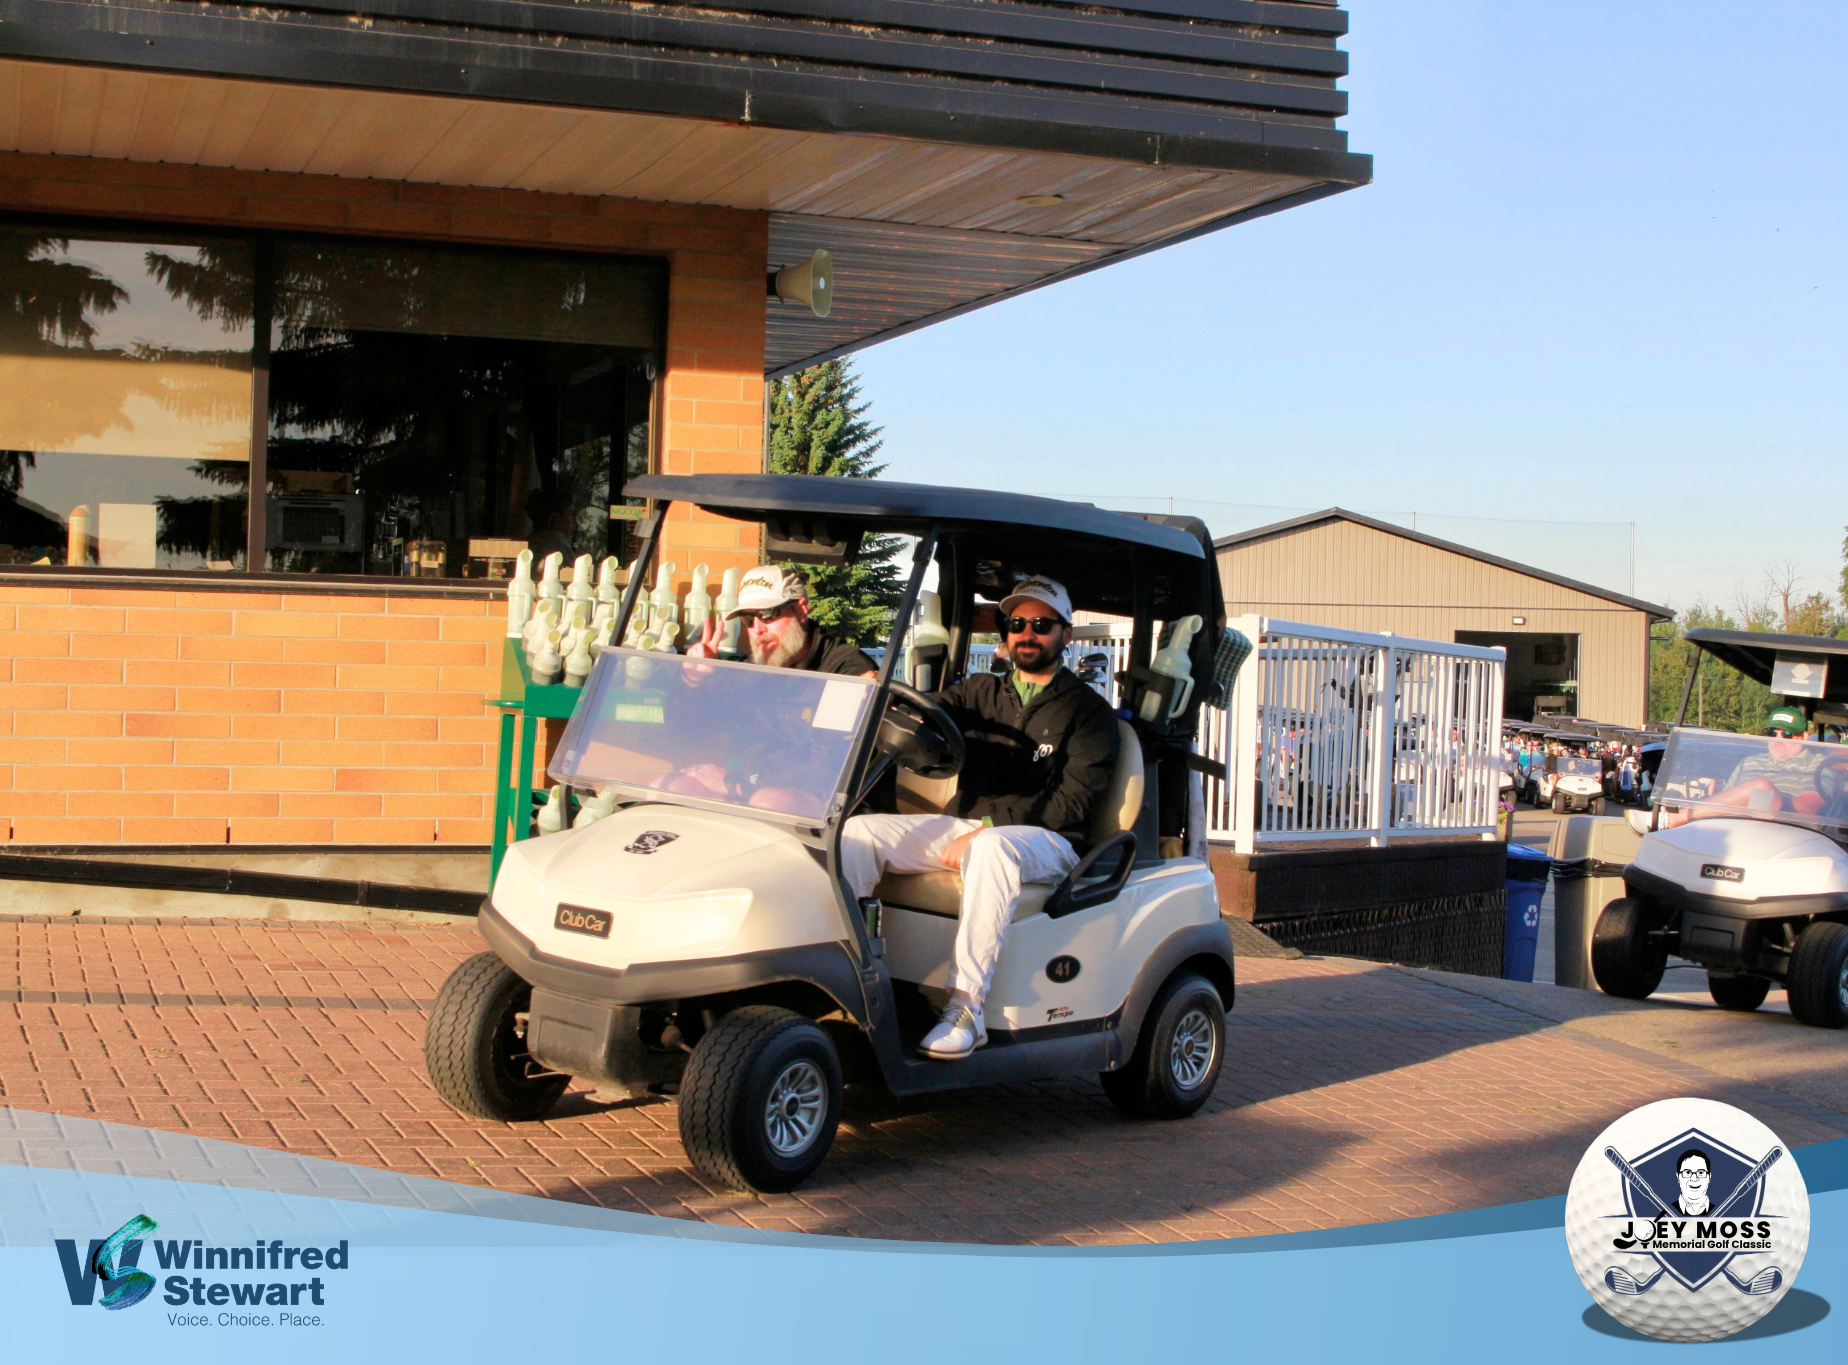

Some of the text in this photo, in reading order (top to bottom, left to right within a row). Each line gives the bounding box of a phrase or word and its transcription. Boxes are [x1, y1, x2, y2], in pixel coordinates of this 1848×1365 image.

[1704, 866, 1740, 879] Club Car
[560, 909, 606, 932] Club Car
[1055, 961, 1071, 977] 41
[1046, 1007, 1074, 1023] Tempo
